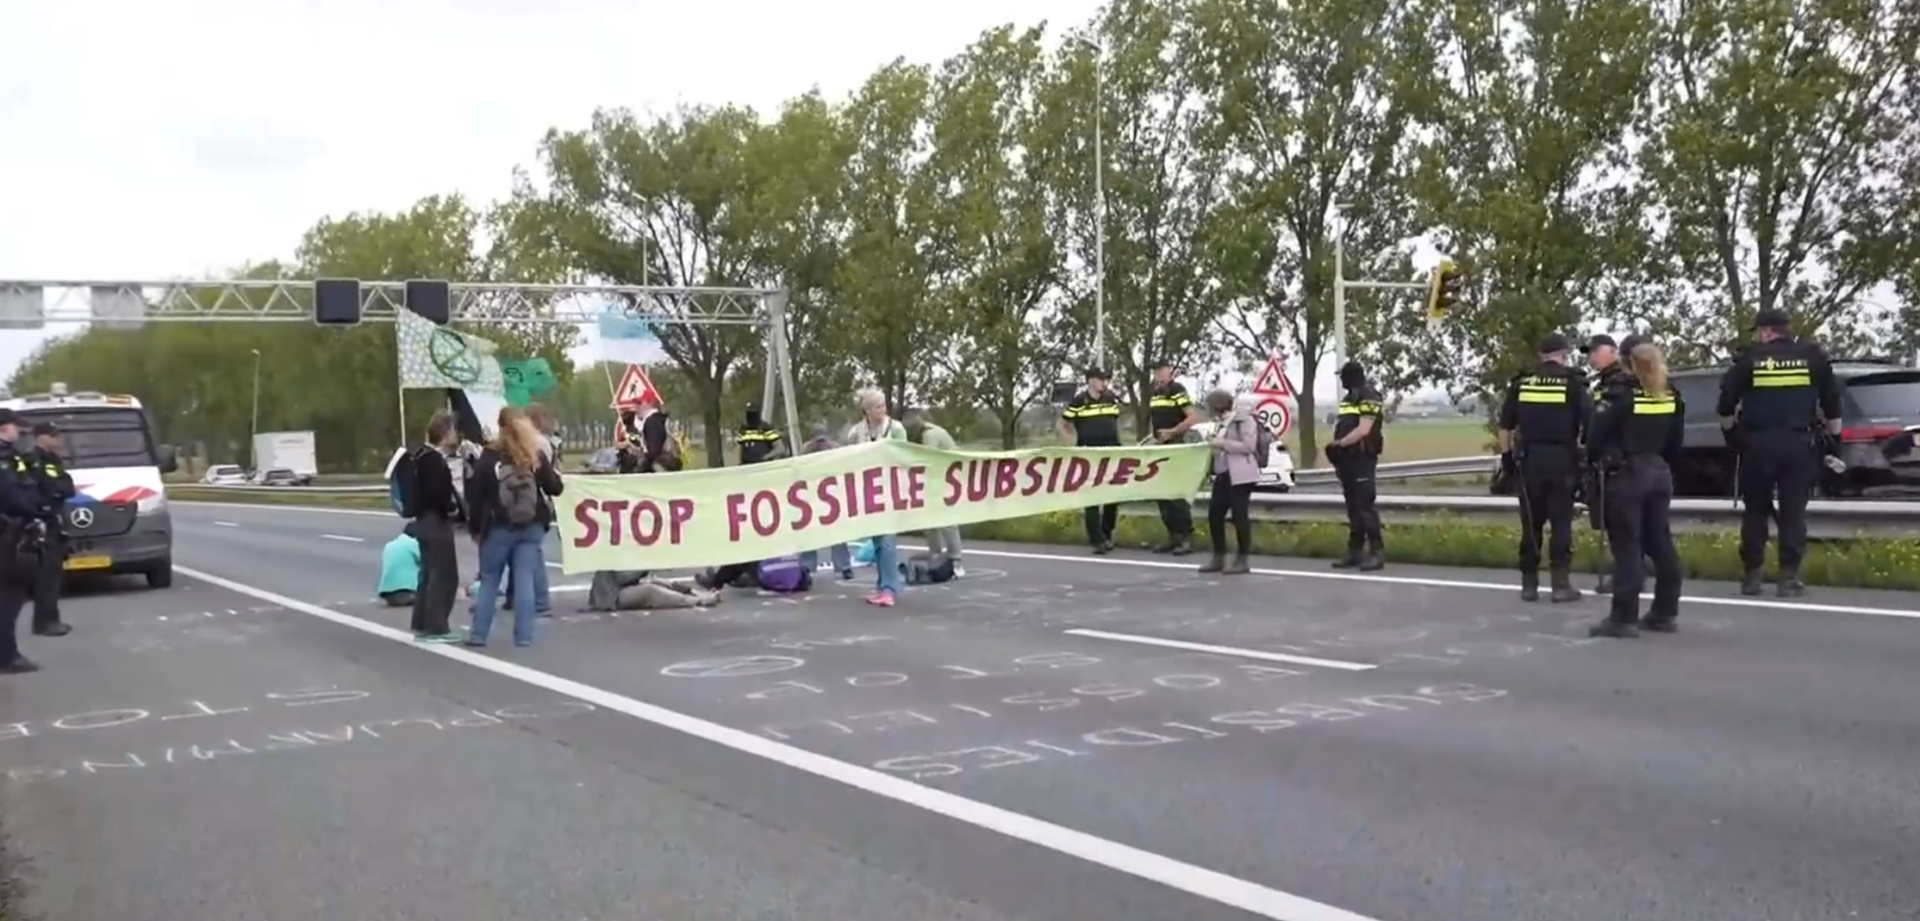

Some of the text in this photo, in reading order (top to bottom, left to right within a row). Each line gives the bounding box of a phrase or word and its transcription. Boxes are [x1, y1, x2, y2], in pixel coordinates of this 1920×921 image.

[1259, 410, 1282, 428] 90
[574, 456, 1170, 547] STOP FOSSIELE SUBSIDIES
